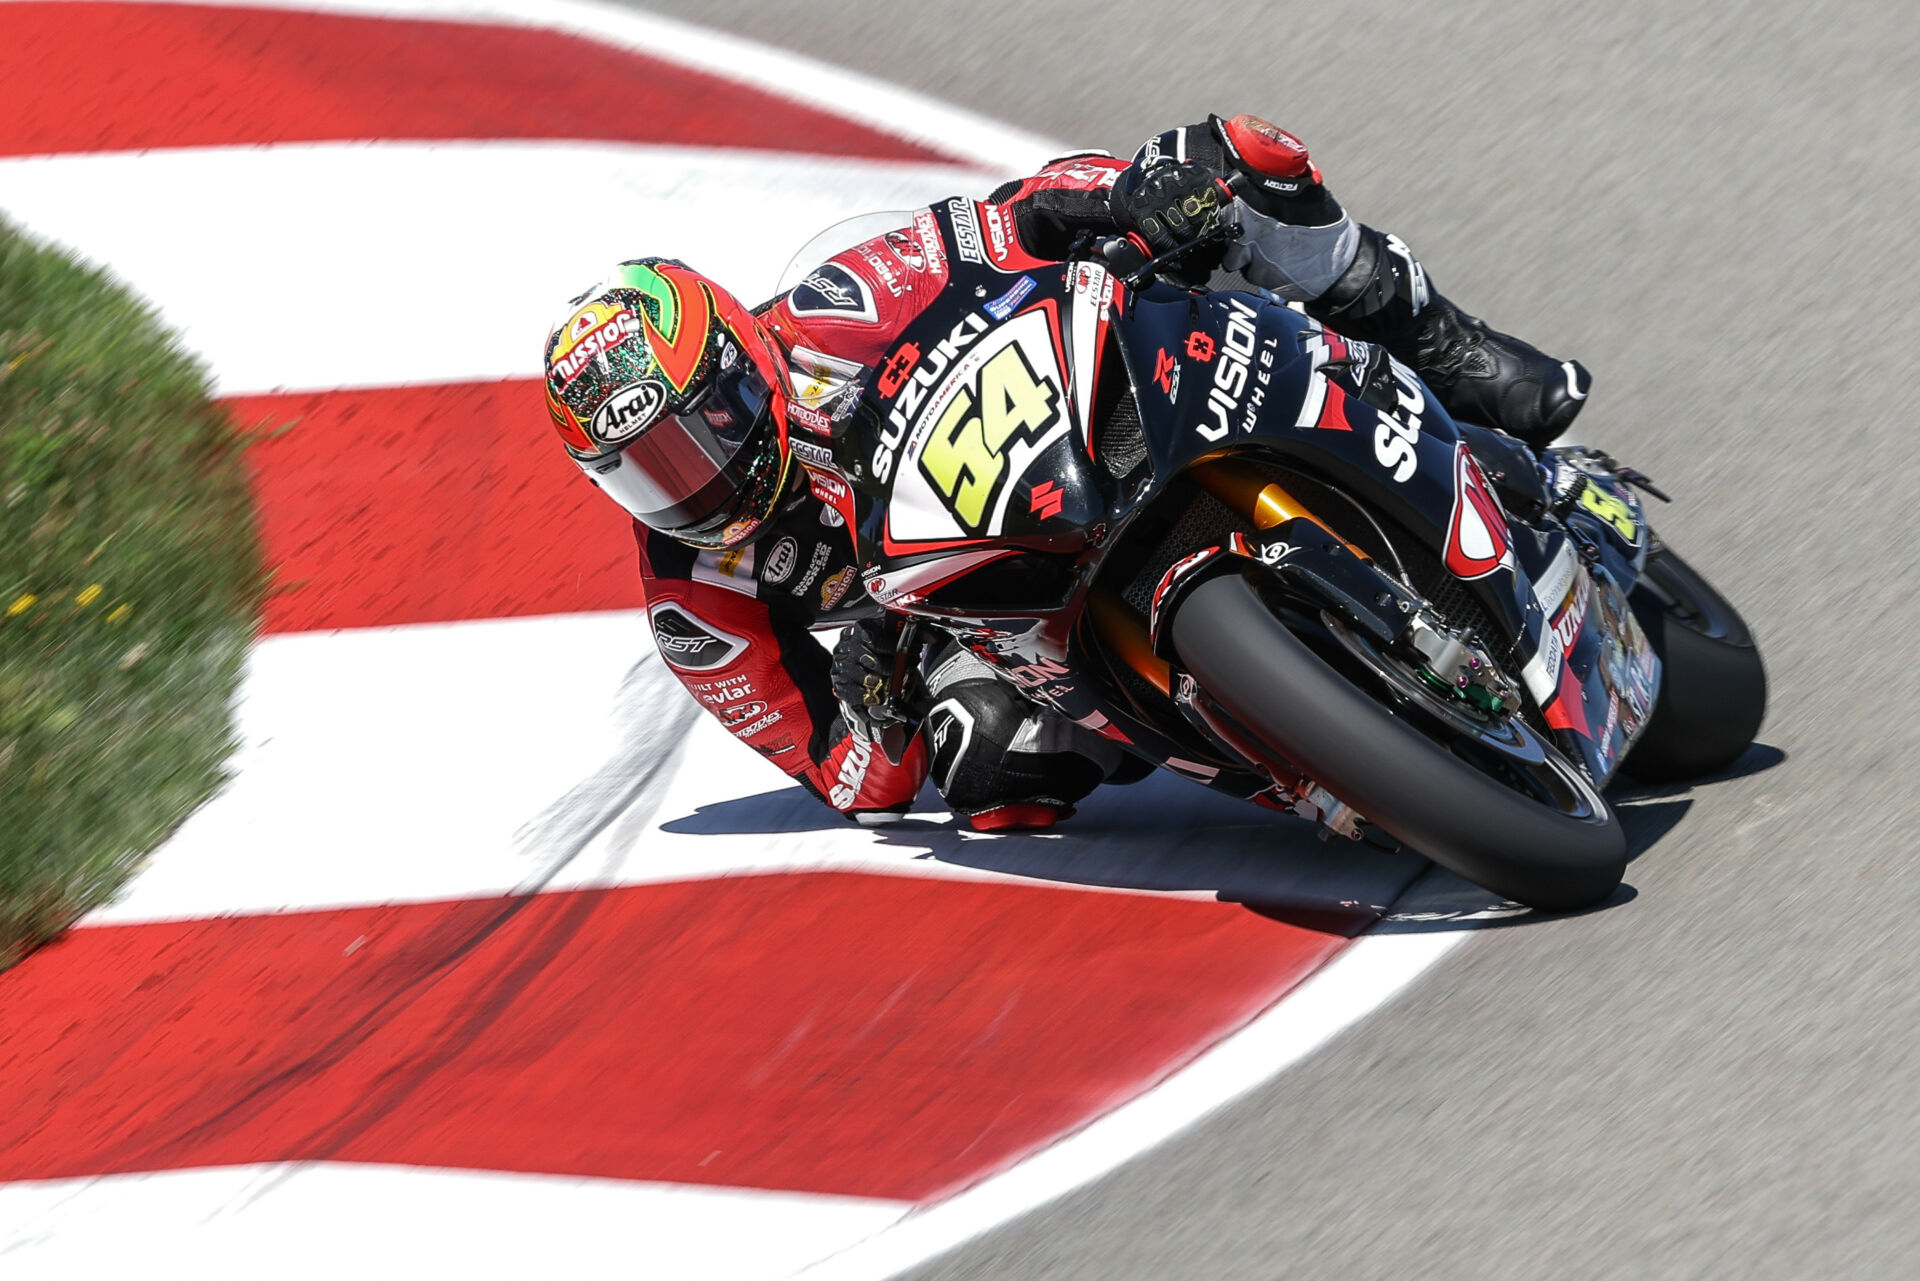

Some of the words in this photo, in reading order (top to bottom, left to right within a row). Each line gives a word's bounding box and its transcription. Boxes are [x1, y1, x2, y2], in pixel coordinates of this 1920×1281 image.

[985, 204, 1009, 262] VISION
[1195, 297, 1258, 442] VISION
[1242, 337, 1278, 433] WHEEL
[600, 385, 656, 438] Arai
[619, 413, 647, 434] HELMET
[787, 401, 829, 428] HOTBODIES
[872, 312, 989, 485] SUZUKI
[920, 342, 1054, 527] 54
[806, 469, 846, 498] VISION
[657, 630, 718, 653] RST
[714, 674, 748, 690] WITH
